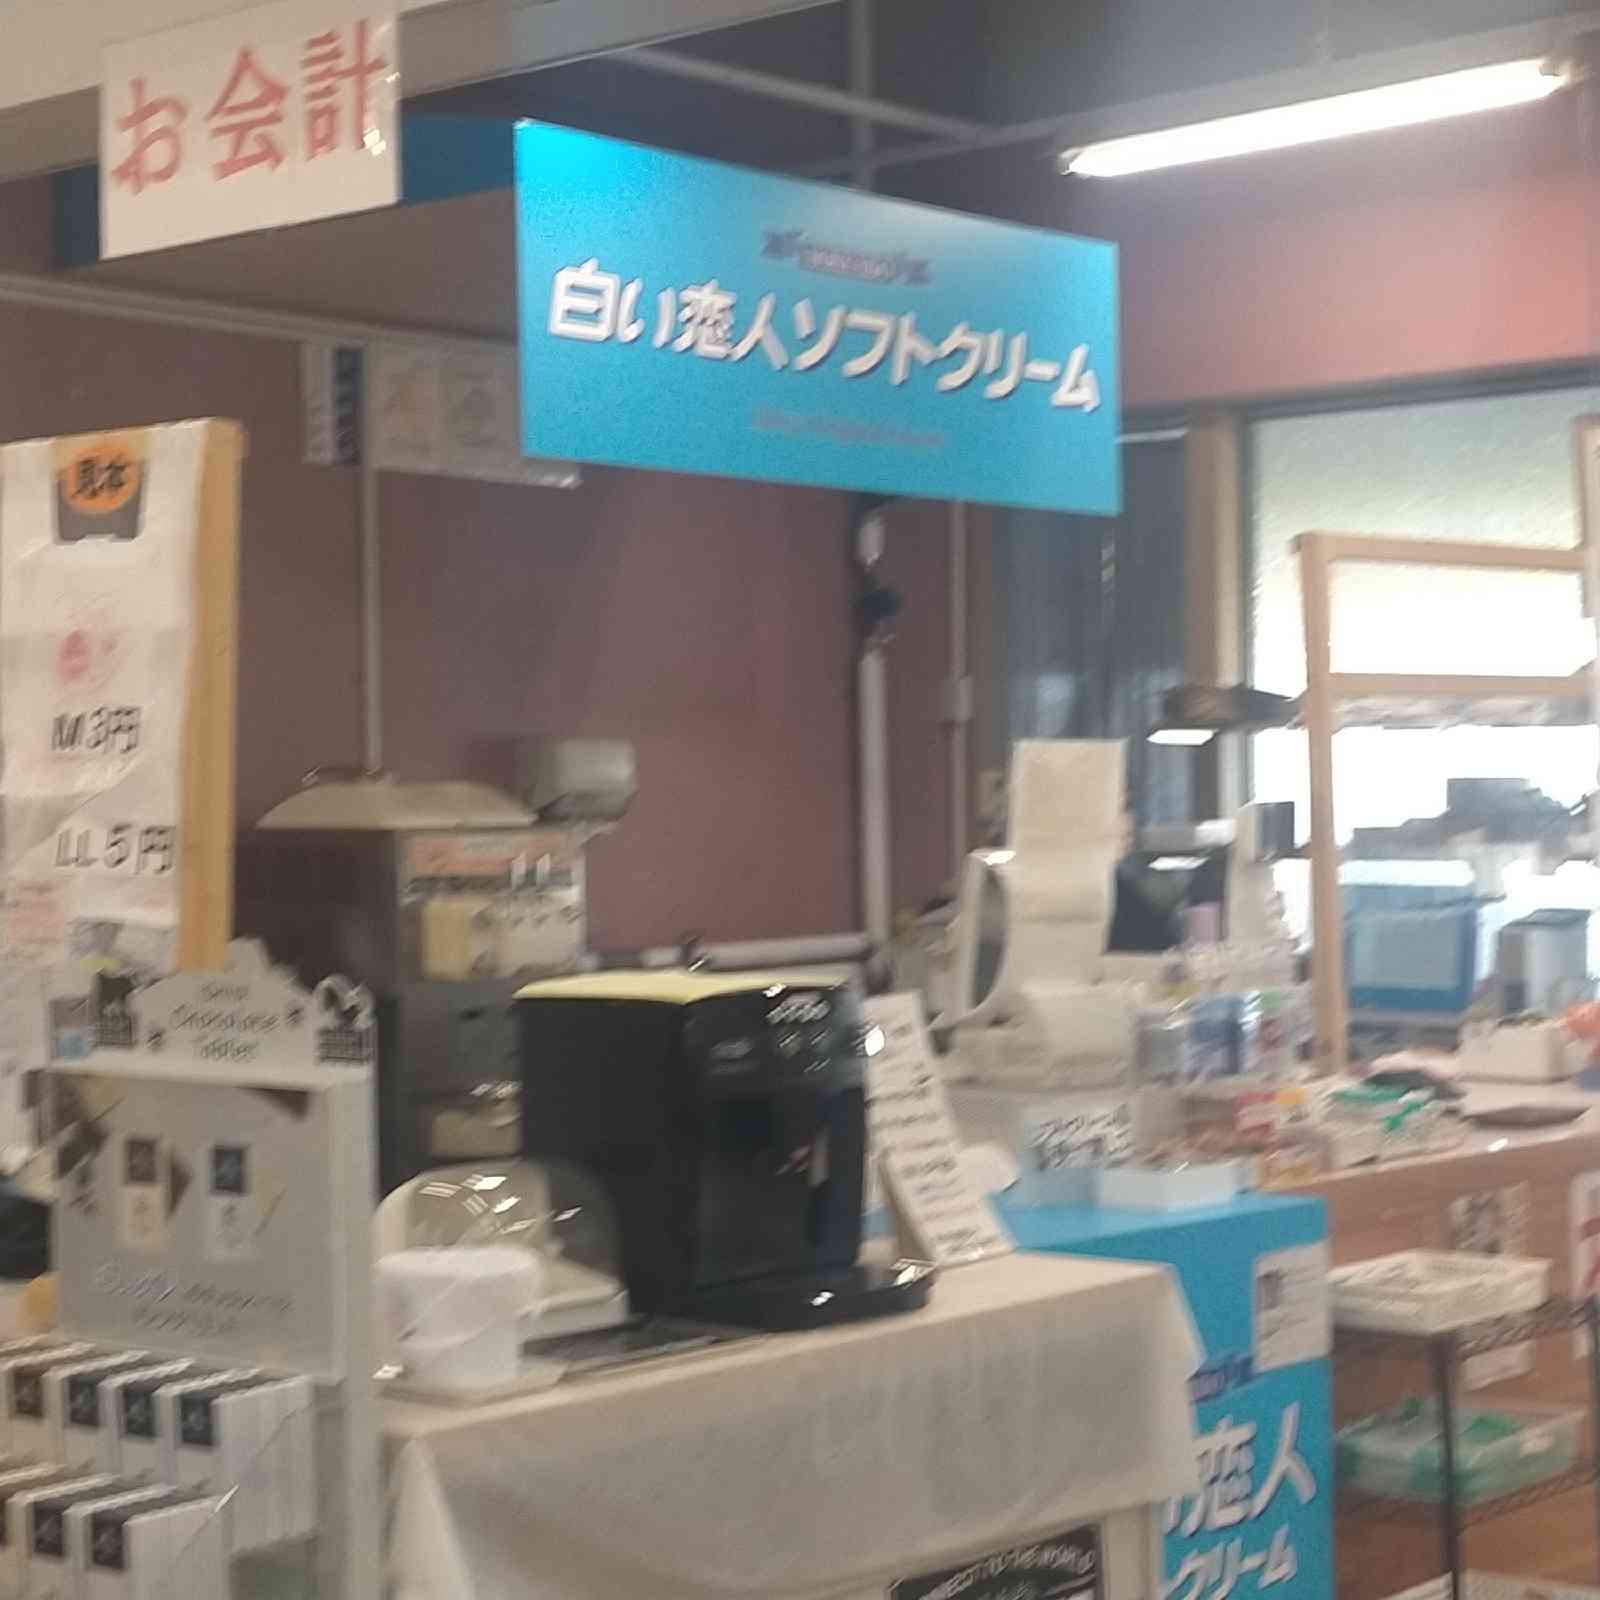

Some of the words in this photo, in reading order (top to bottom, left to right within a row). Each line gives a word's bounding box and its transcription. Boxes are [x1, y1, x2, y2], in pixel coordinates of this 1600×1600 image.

[111, 19, 388, 195] お会計
[546, 257, 1100, 413] 白い恋人ソフトクリーム
